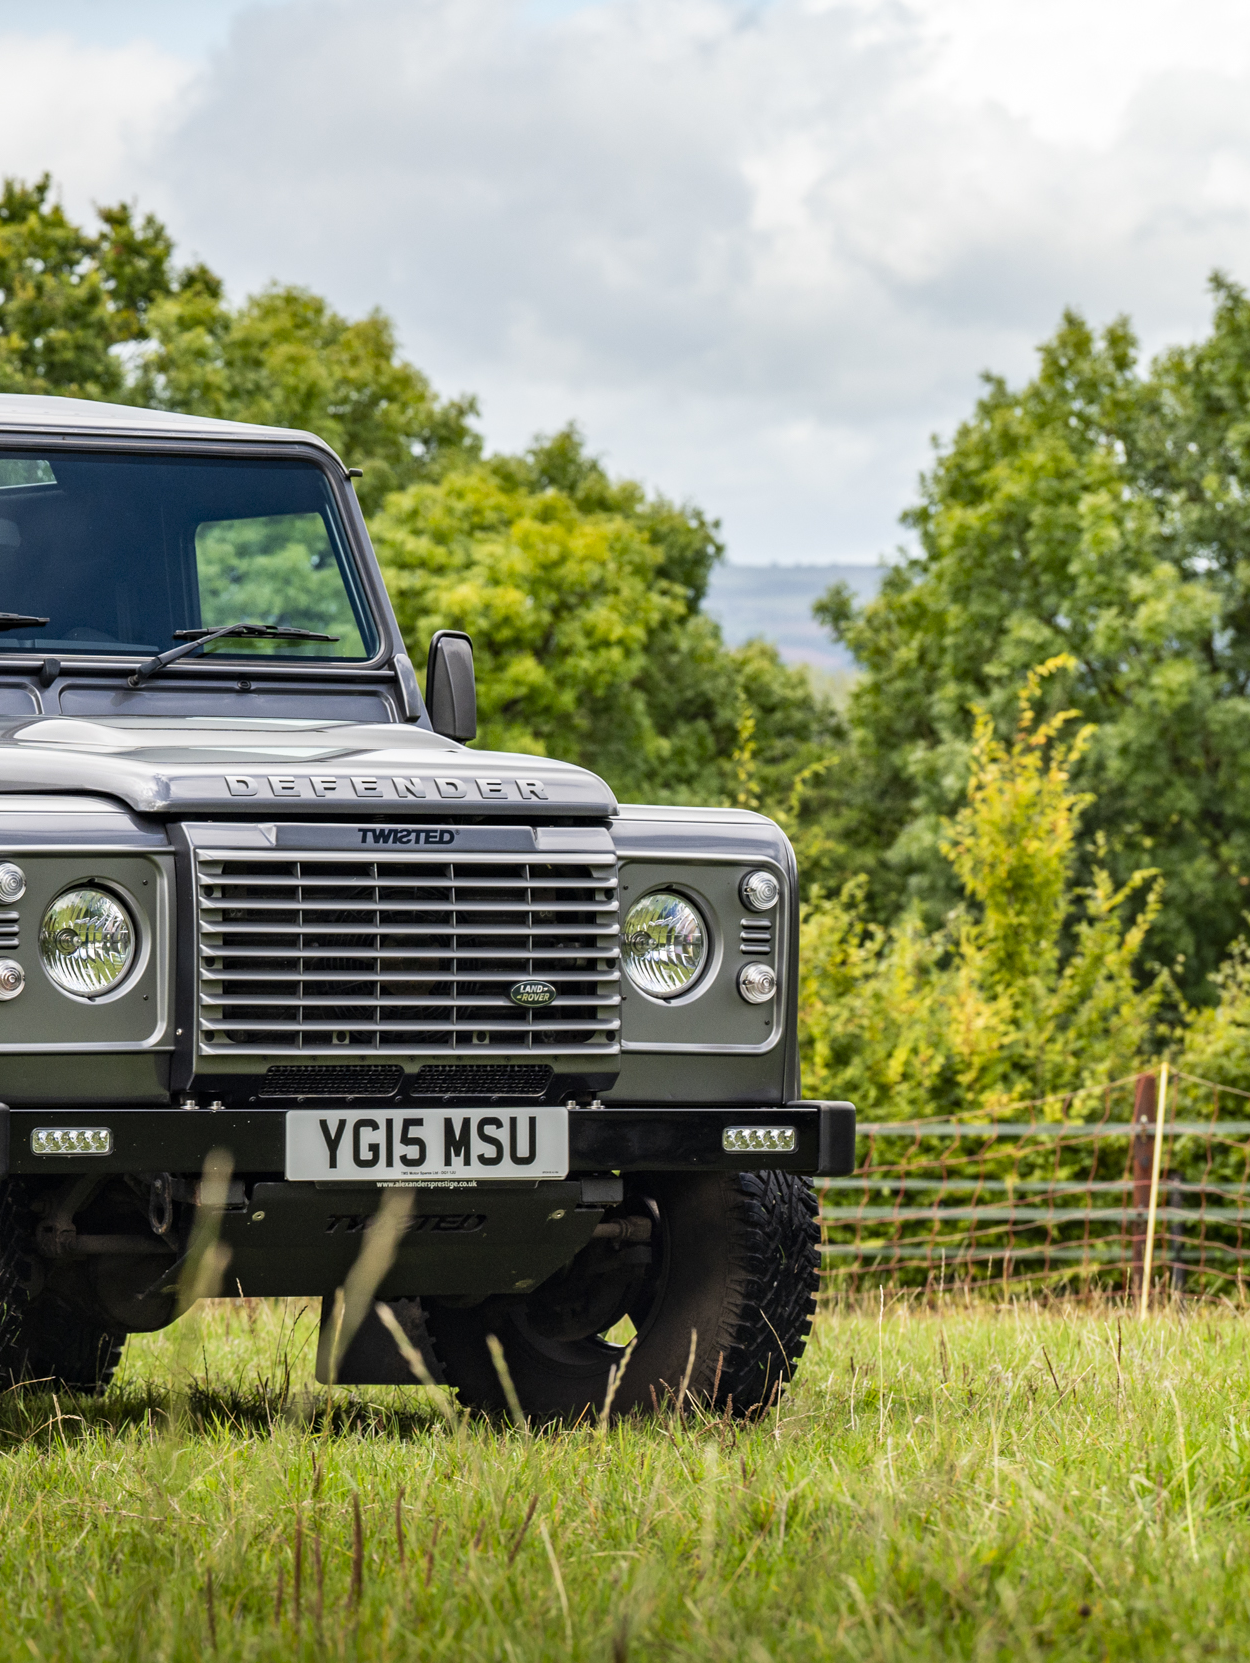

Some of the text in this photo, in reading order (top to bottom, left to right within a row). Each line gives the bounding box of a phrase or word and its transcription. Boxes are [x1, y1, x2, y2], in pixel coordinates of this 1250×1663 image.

[224, 775, 550, 801] DEFENDER
[358, 827, 456, 845] TWISTED
[520, 984, 544, 993] LAND
[521, 993, 550, 1002] ROVER
[319, 1115, 538, 1170] YG15 MSU
[376, 1179, 478, 1190] www.alexandersprestige.co.uk
[324, 1213, 488, 1234] TWSTED
